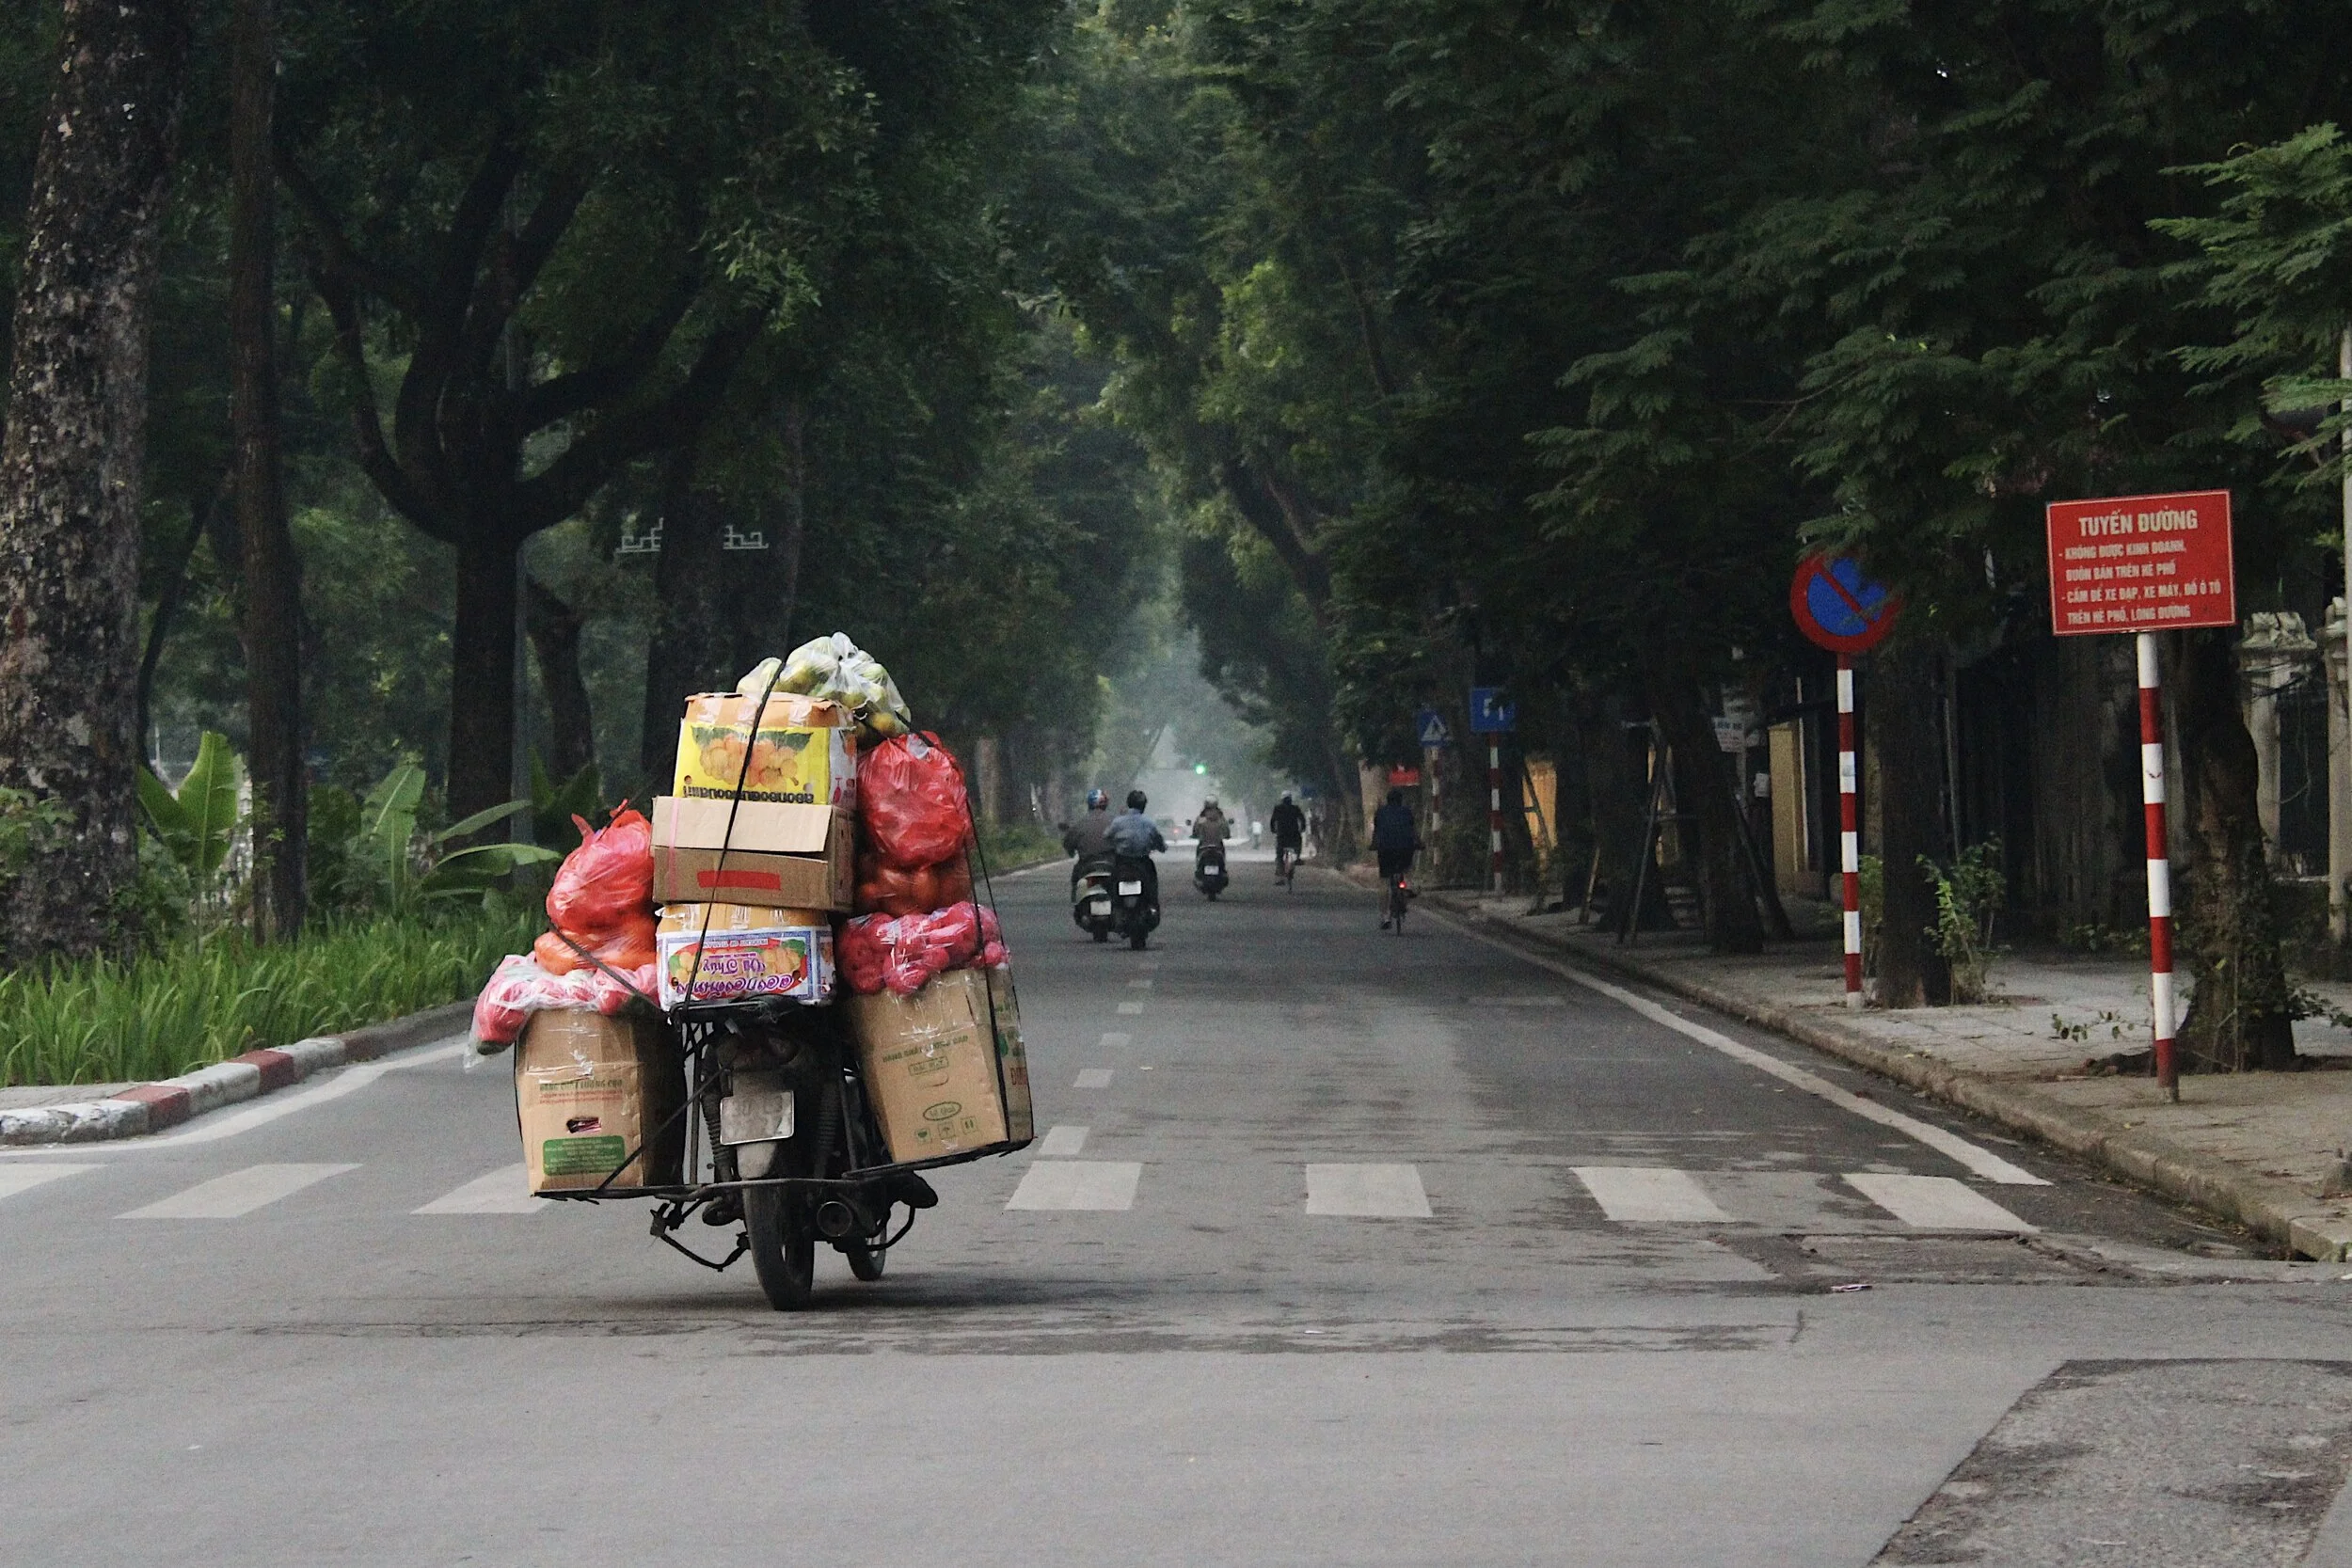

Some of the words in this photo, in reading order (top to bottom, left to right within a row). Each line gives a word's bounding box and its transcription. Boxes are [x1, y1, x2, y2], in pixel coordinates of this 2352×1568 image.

[2078, 509, 2133, 536] TUYẾN
[2137, 505, 2198, 532] ĐƯỜNG
[2105, 587, 2118, 601] XE
[2143, 584, 2156, 599] XE
[2200, 579, 2207, 594] Ô
[2209, 578, 2221, 594] TÔ
